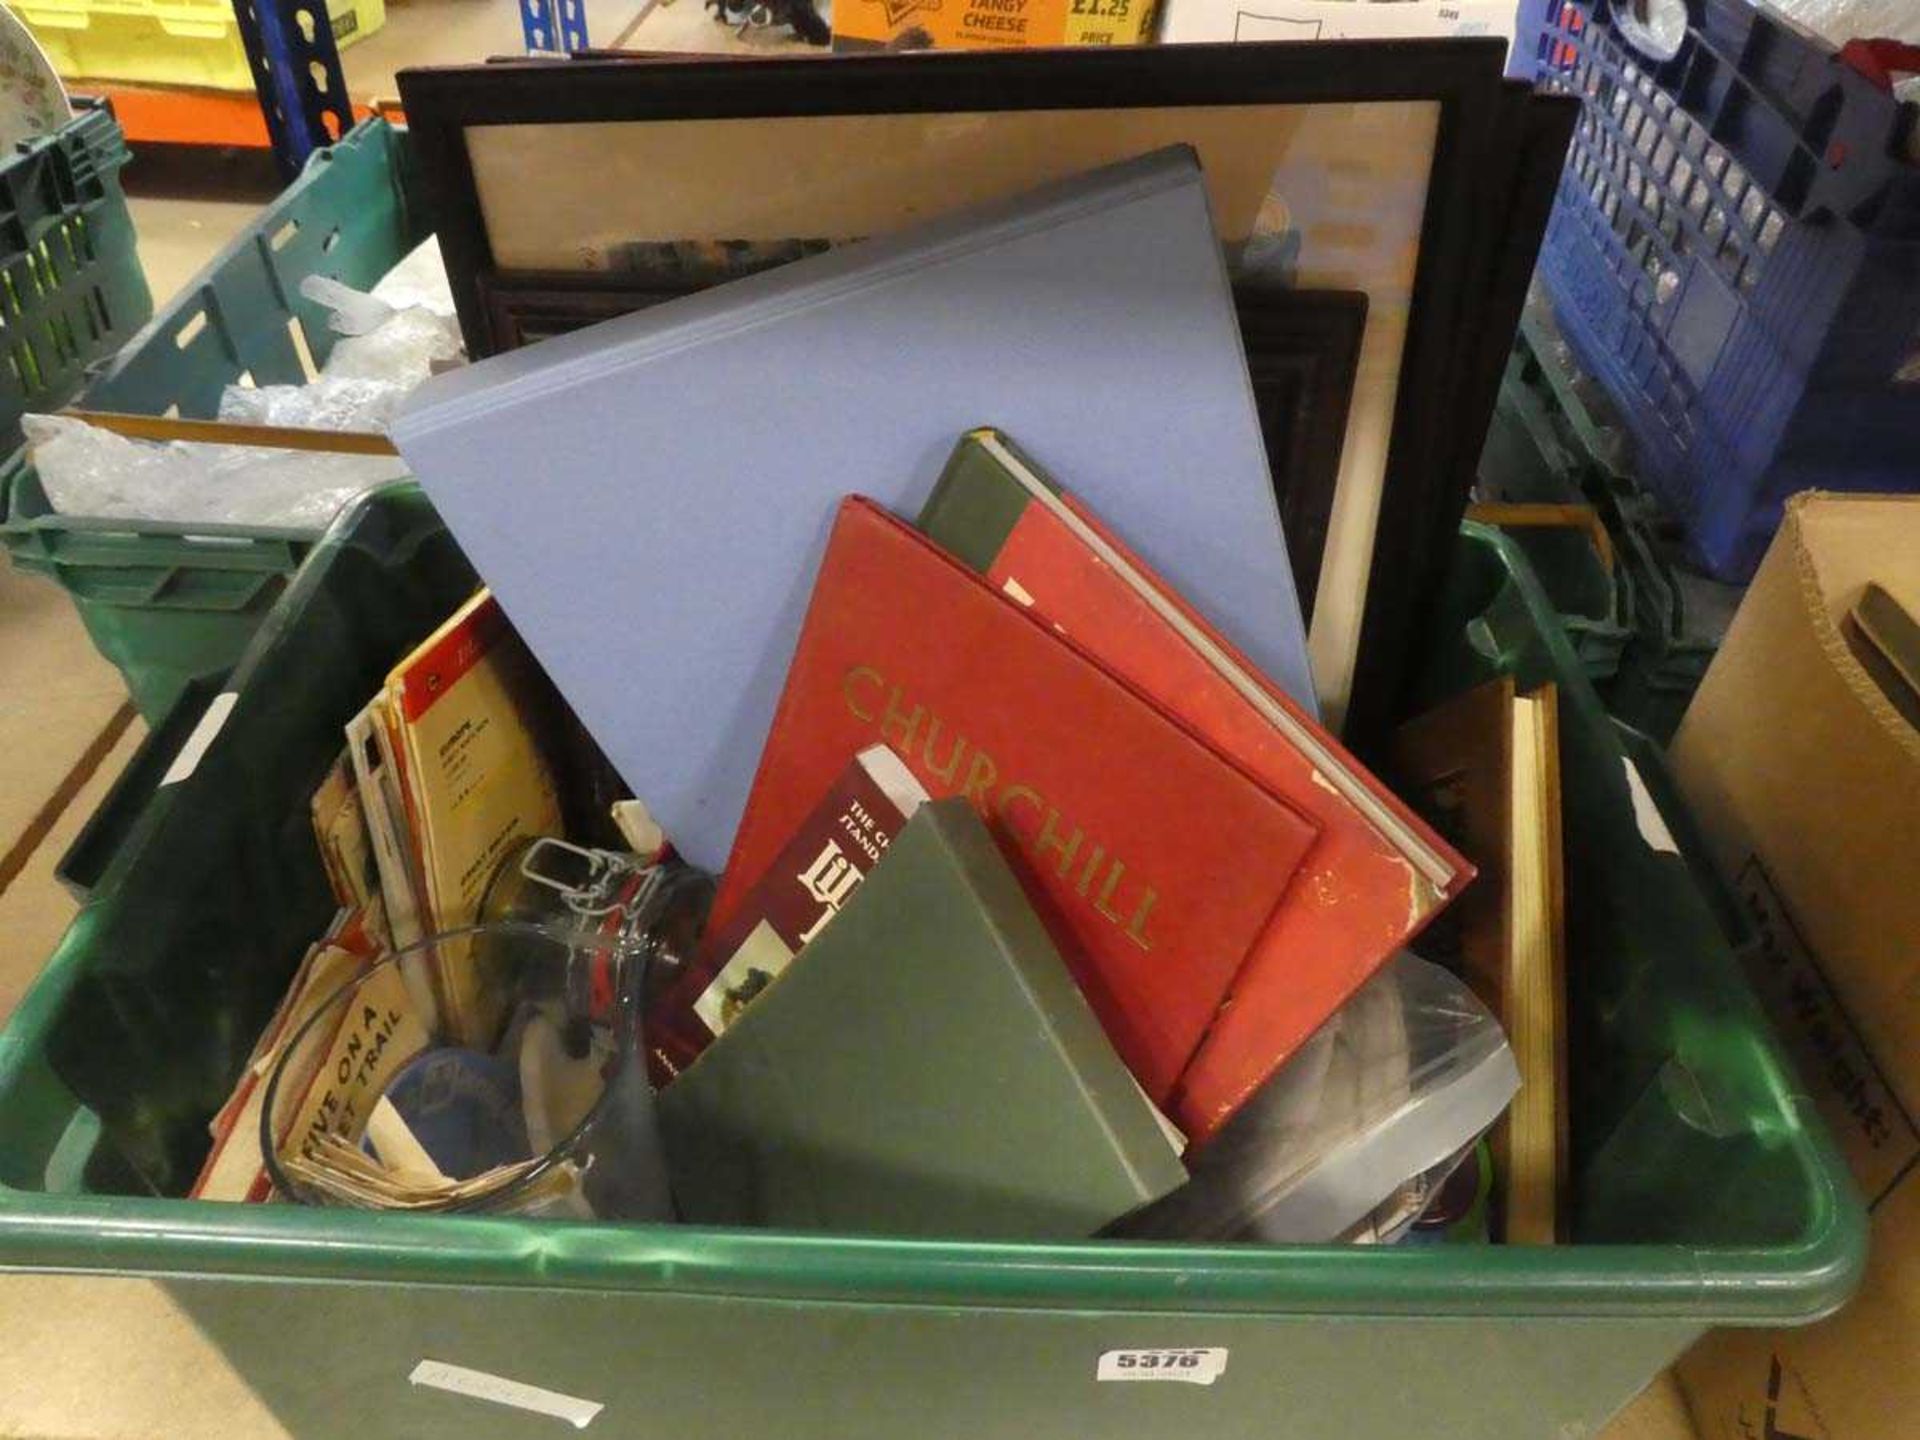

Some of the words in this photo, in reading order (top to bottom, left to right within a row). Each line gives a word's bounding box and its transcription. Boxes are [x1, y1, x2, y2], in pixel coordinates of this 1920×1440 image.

[970, 0, 1026, 13] TANGY
[1071, 0, 1131, 16] £1.25
[963, 13, 1028, 33] CHEESE
[1079, 31, 1114, 45] PRICE
[843, 665, 1156, 950] CHURCHILL
[850, 800, 876, 832] THE
[838, 814, 881, 864] STAND
[355, 1009, 403, 1087] TRAIL
[300, 1088, 339, 1161] FIVE
[337, 1032, 362, 1086] ON
[362, 1004, 378, 1033] A
[1116, 1353, 1200, 1369] 5376
